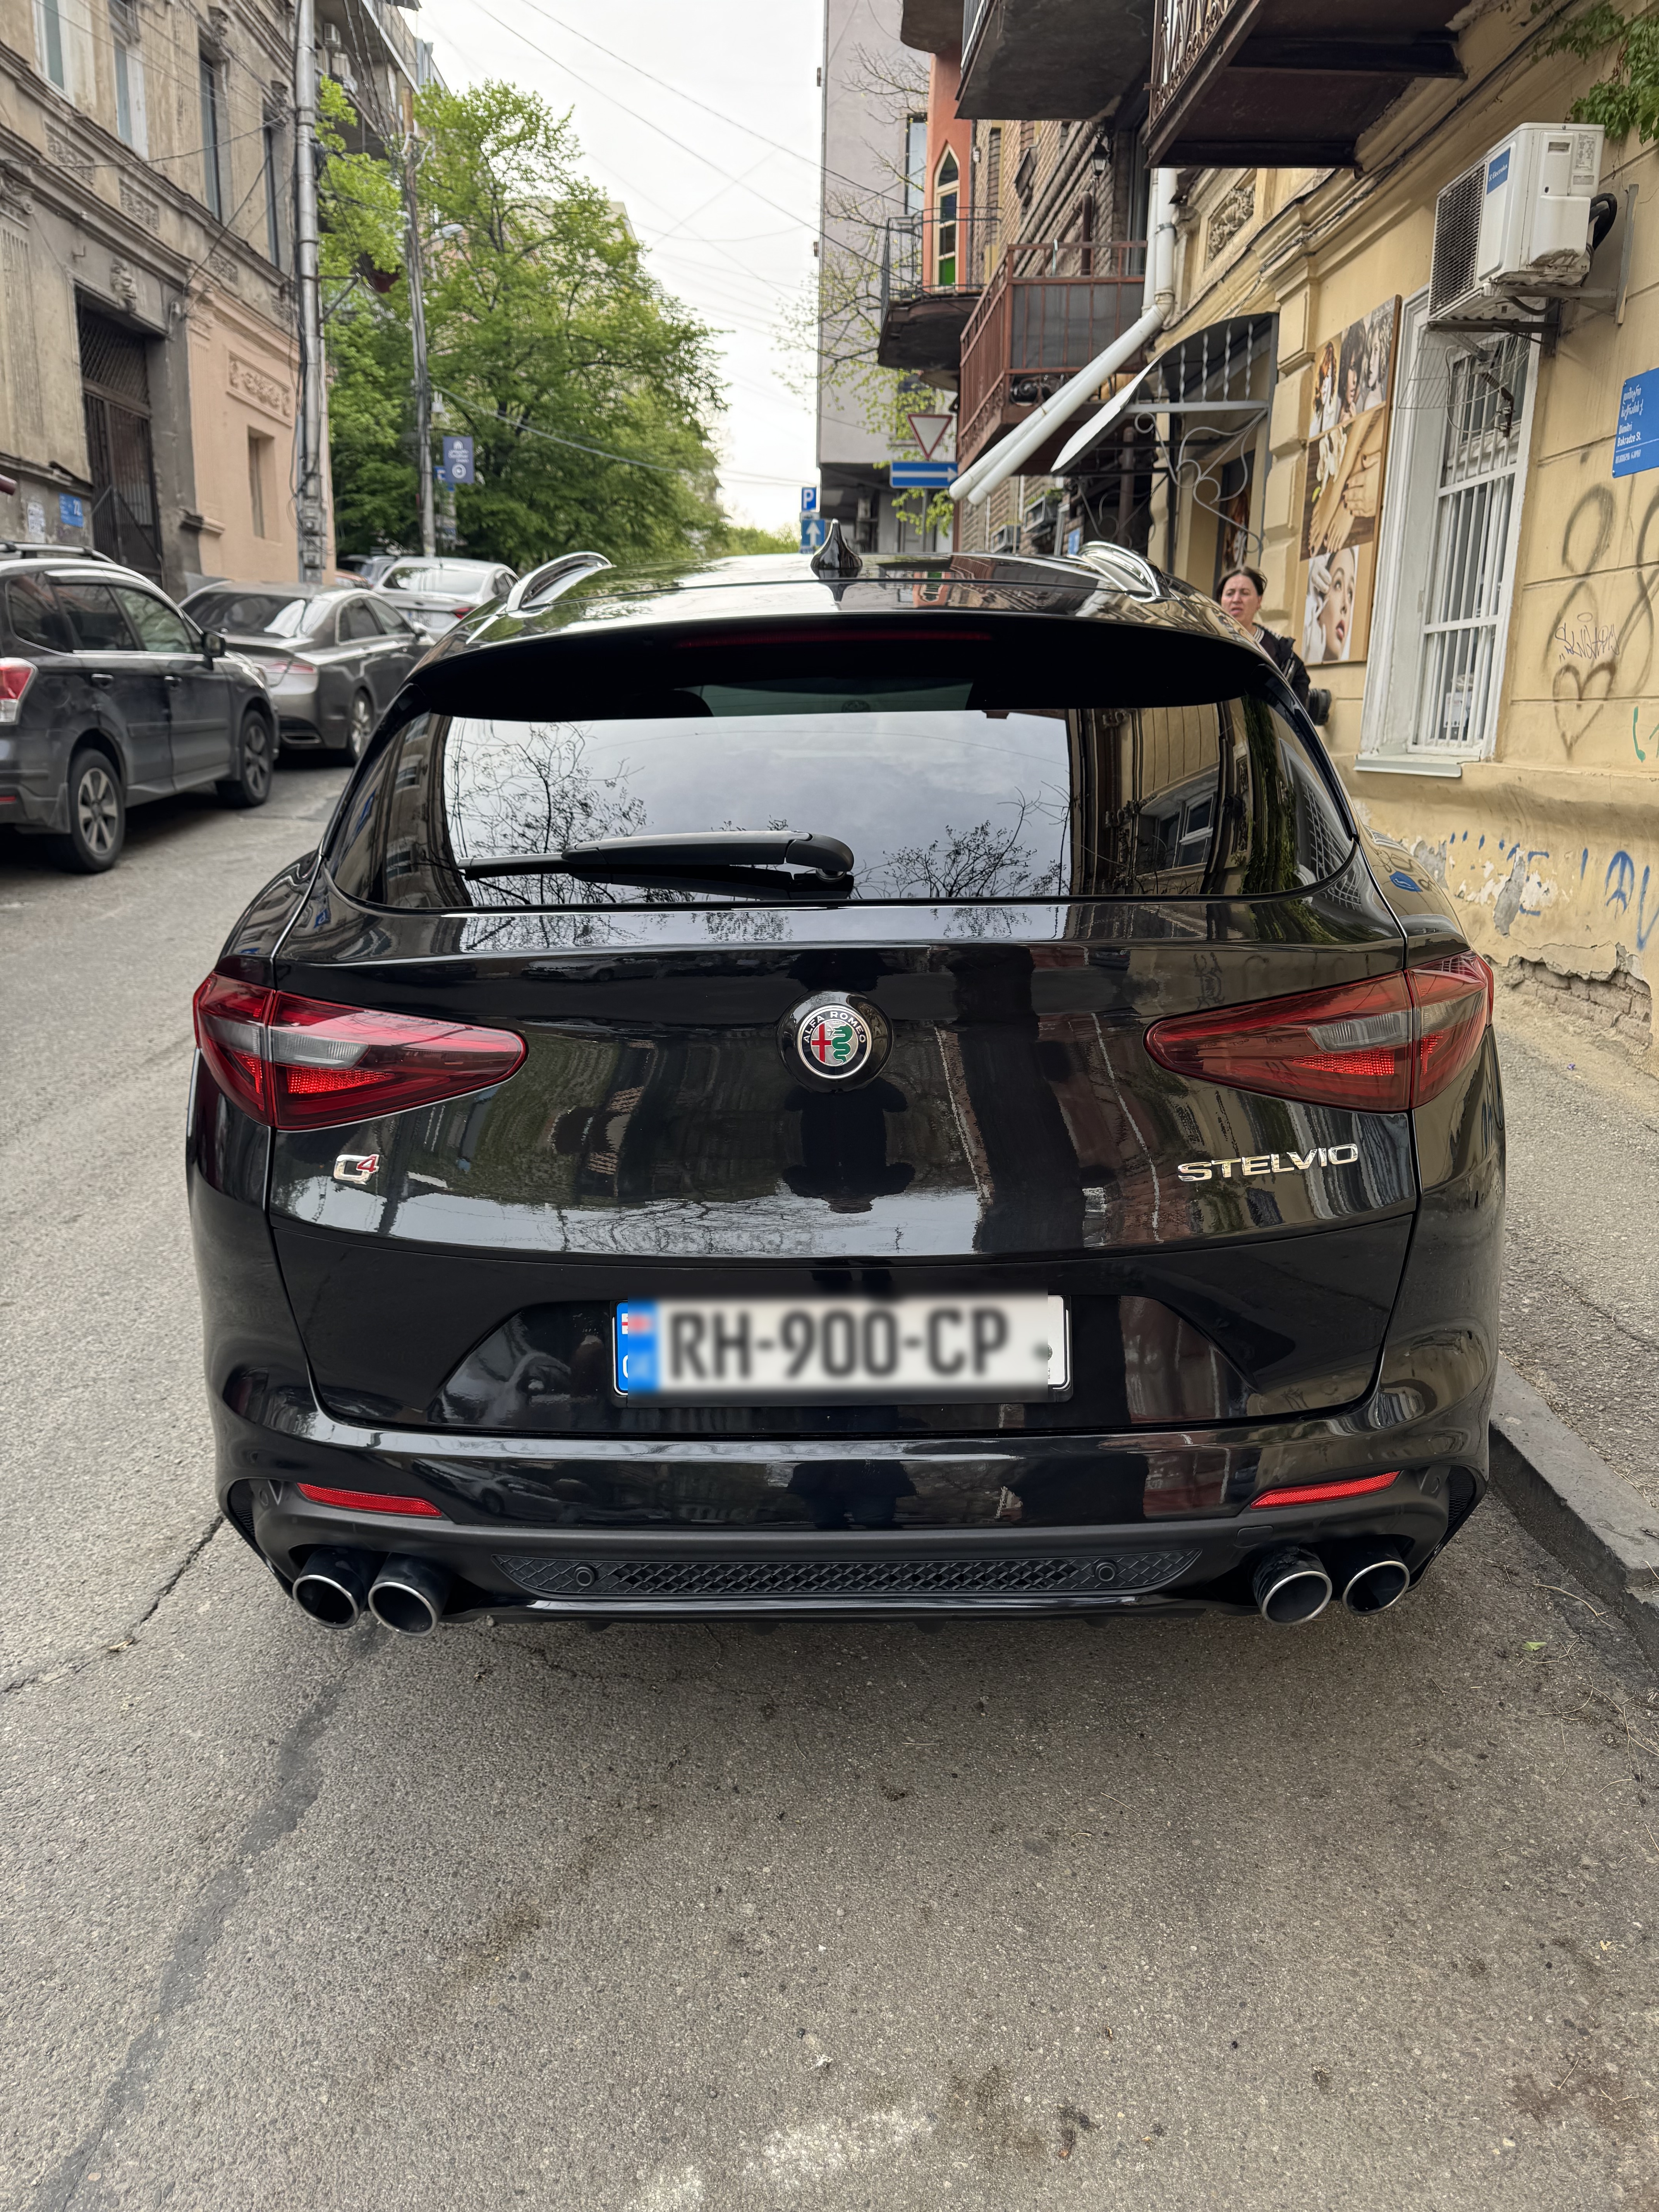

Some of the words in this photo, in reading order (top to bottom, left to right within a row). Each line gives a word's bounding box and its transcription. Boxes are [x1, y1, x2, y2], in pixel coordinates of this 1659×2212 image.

[1617, 433, 1635, 447] Bakradze
[1619, 422, 1632, 434] Dimitri
[804, 489, 814, 508] P
[804, 1015, 825, 1043] ALFA
[830, 1011, 866, 1043] ROMEO
[333, 1154, 380, 1185] Q4
[1178, 1143, 1358, 1182] STELVIO
[669, 1309, 1010, 1378] RH-900-CP
